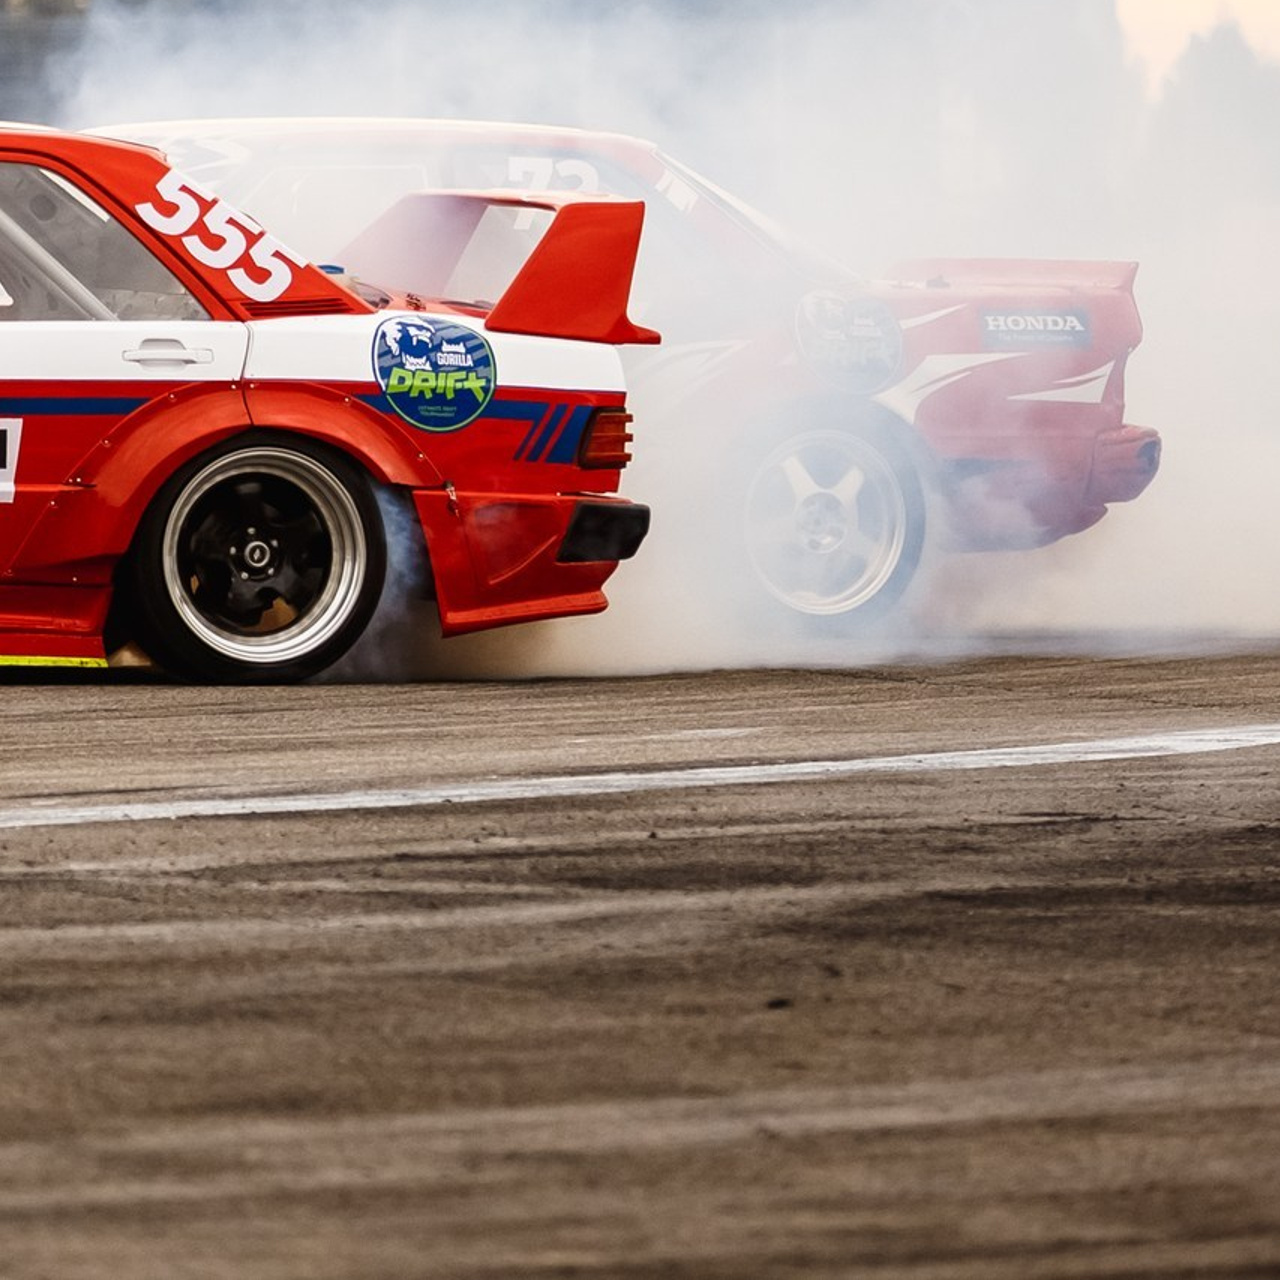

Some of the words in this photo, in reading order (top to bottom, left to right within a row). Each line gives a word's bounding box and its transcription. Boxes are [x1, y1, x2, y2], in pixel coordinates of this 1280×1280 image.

[134, 169, 310, 302] 555
[984, 315, 1085, 331] HONDA
[436, 352, 474, 367] GORILLA
[386, 367, 487, 403] DRIFT
